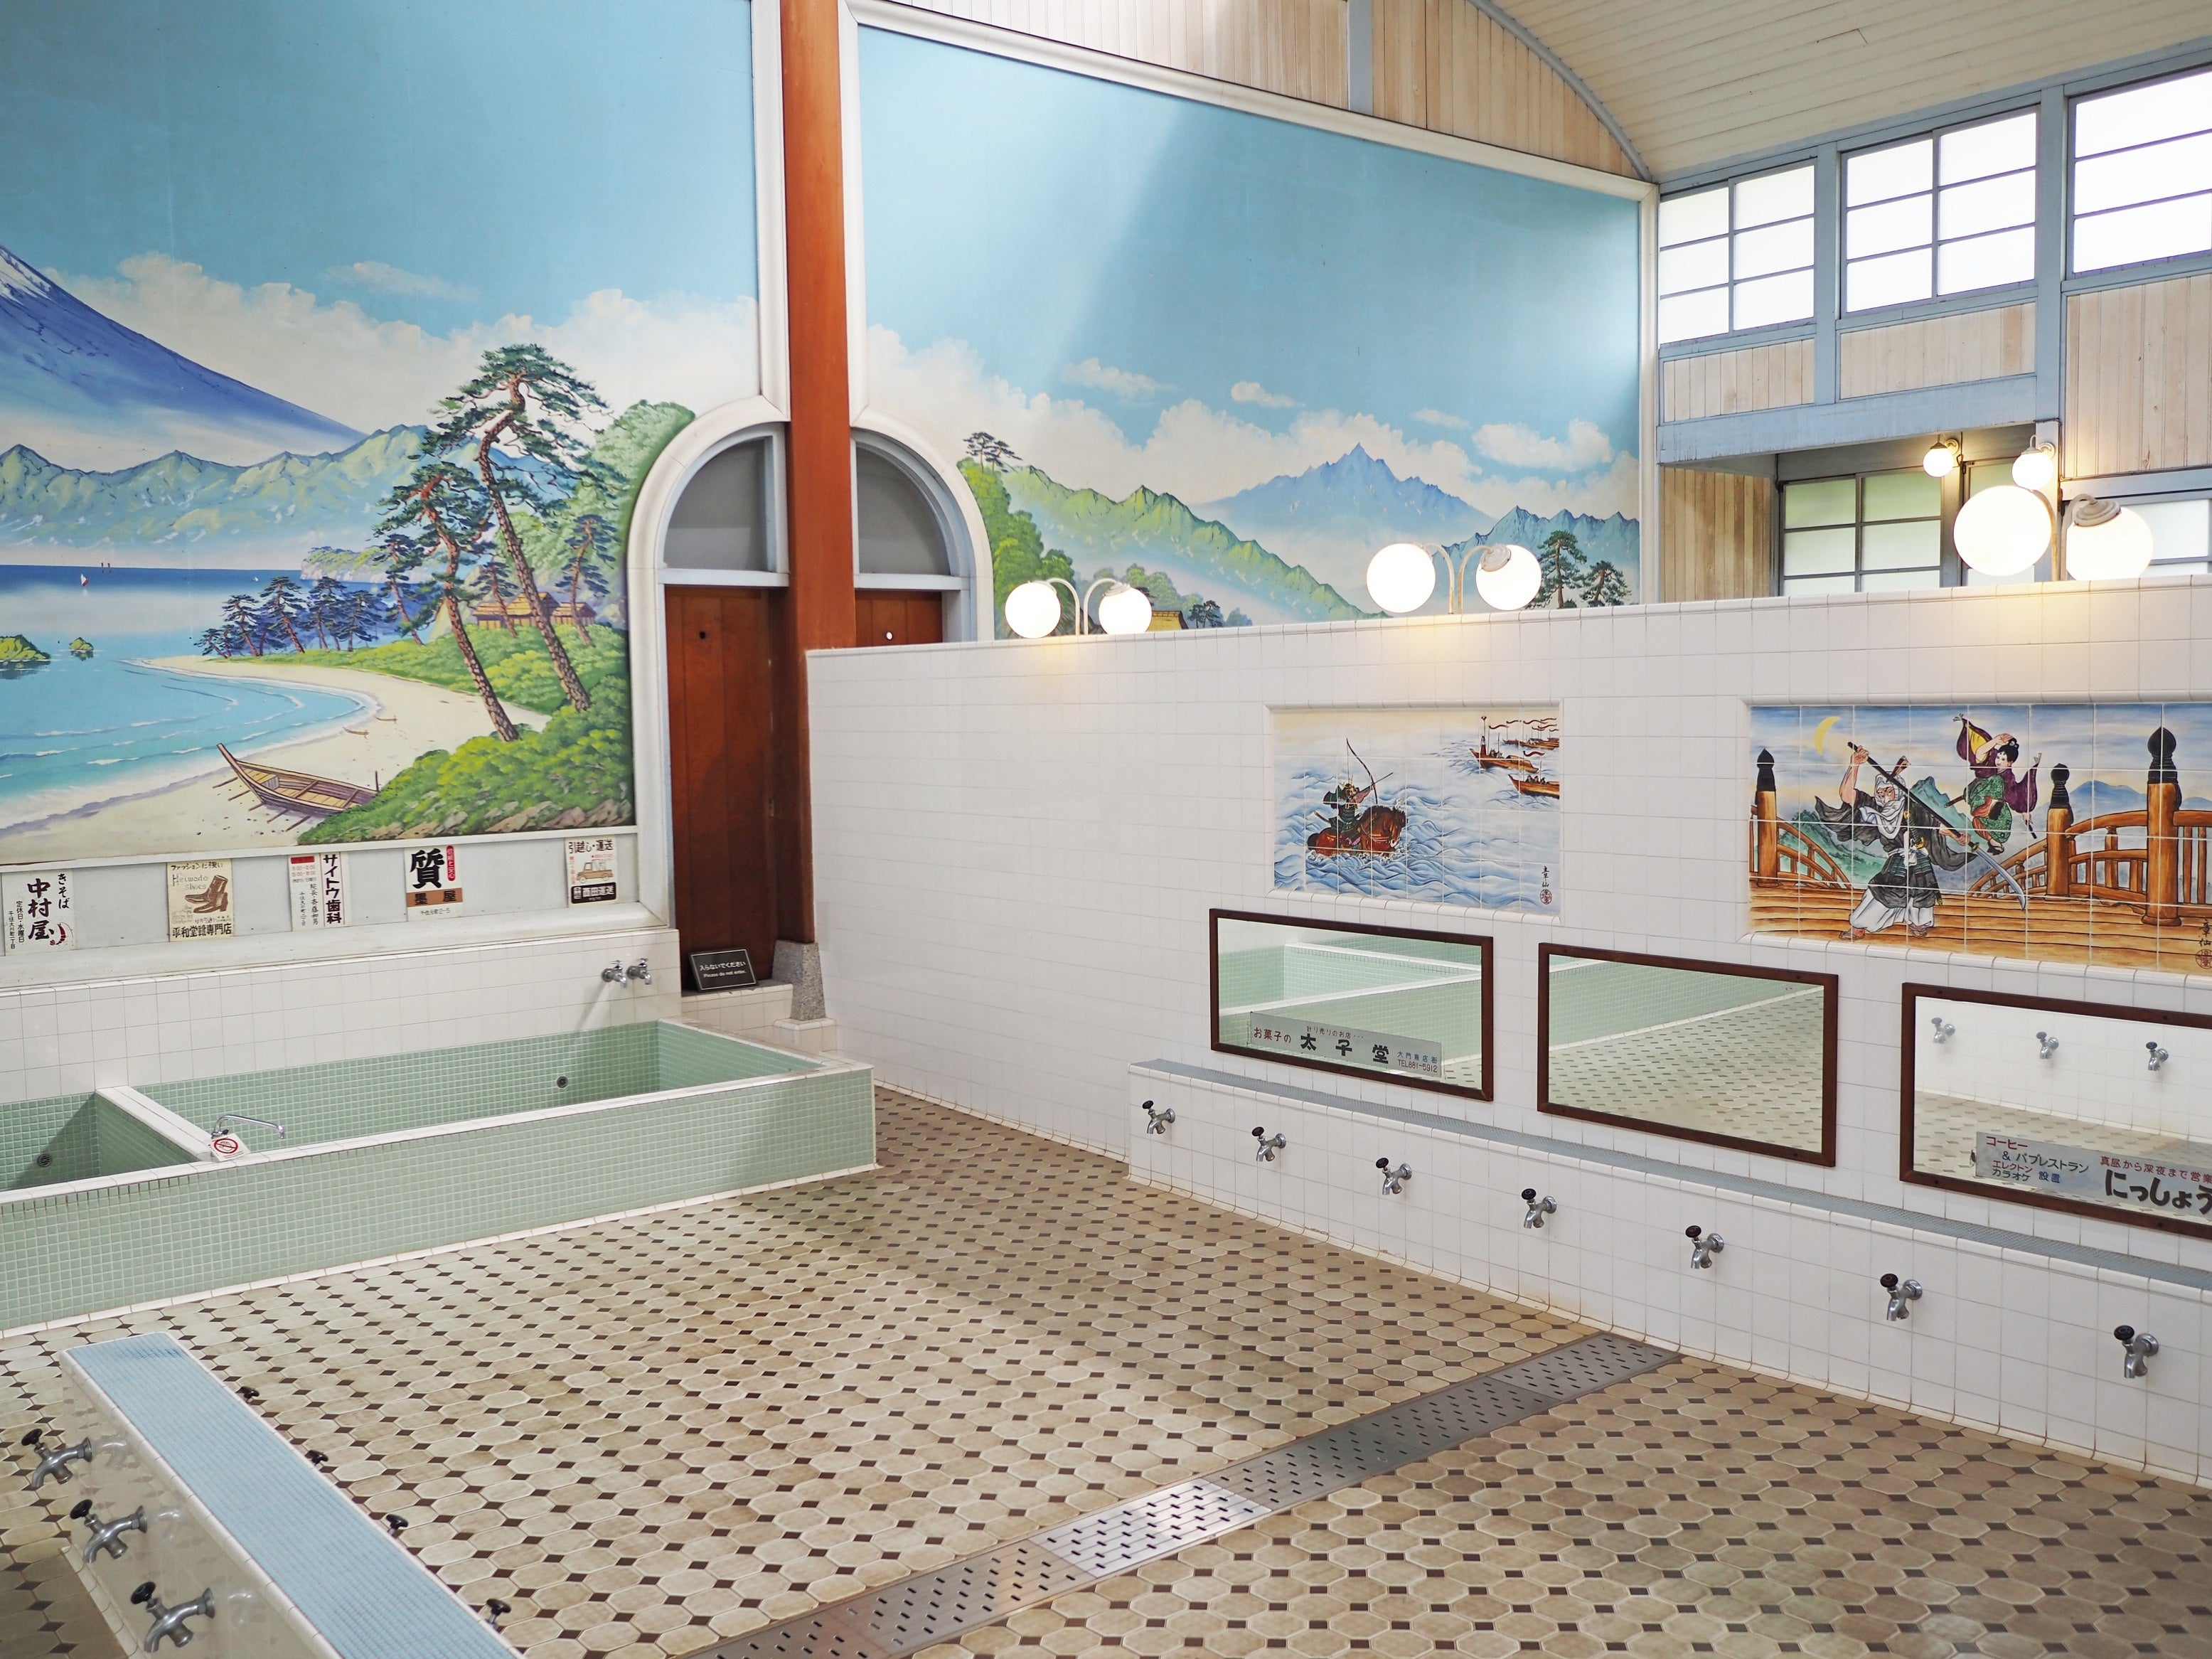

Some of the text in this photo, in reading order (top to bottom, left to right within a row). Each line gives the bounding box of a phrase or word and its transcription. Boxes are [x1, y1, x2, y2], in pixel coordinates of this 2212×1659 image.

[410, 848, 444, 889] 質
[58, 873, 70, 909] きそば
[323, 854, 342, 924] サイトウ歯科
[27, 878, 54, 940] 中村屋
[700, 961, 746, 971] 入らないでください
[1254, 1027, 1291, 1044] お菓子の
[1300, 1033, 1389, 1065] 太子堂
[1986, 1136, 2028, 1150] コーヒー
[2002, 1151, 2011, 1161] &
[1992, 1160, 2033, 1173] エレクトン
[1992, 1168, 2031, 1182] カラオケ
[2039, 1170, 2061, 1183] 設置
